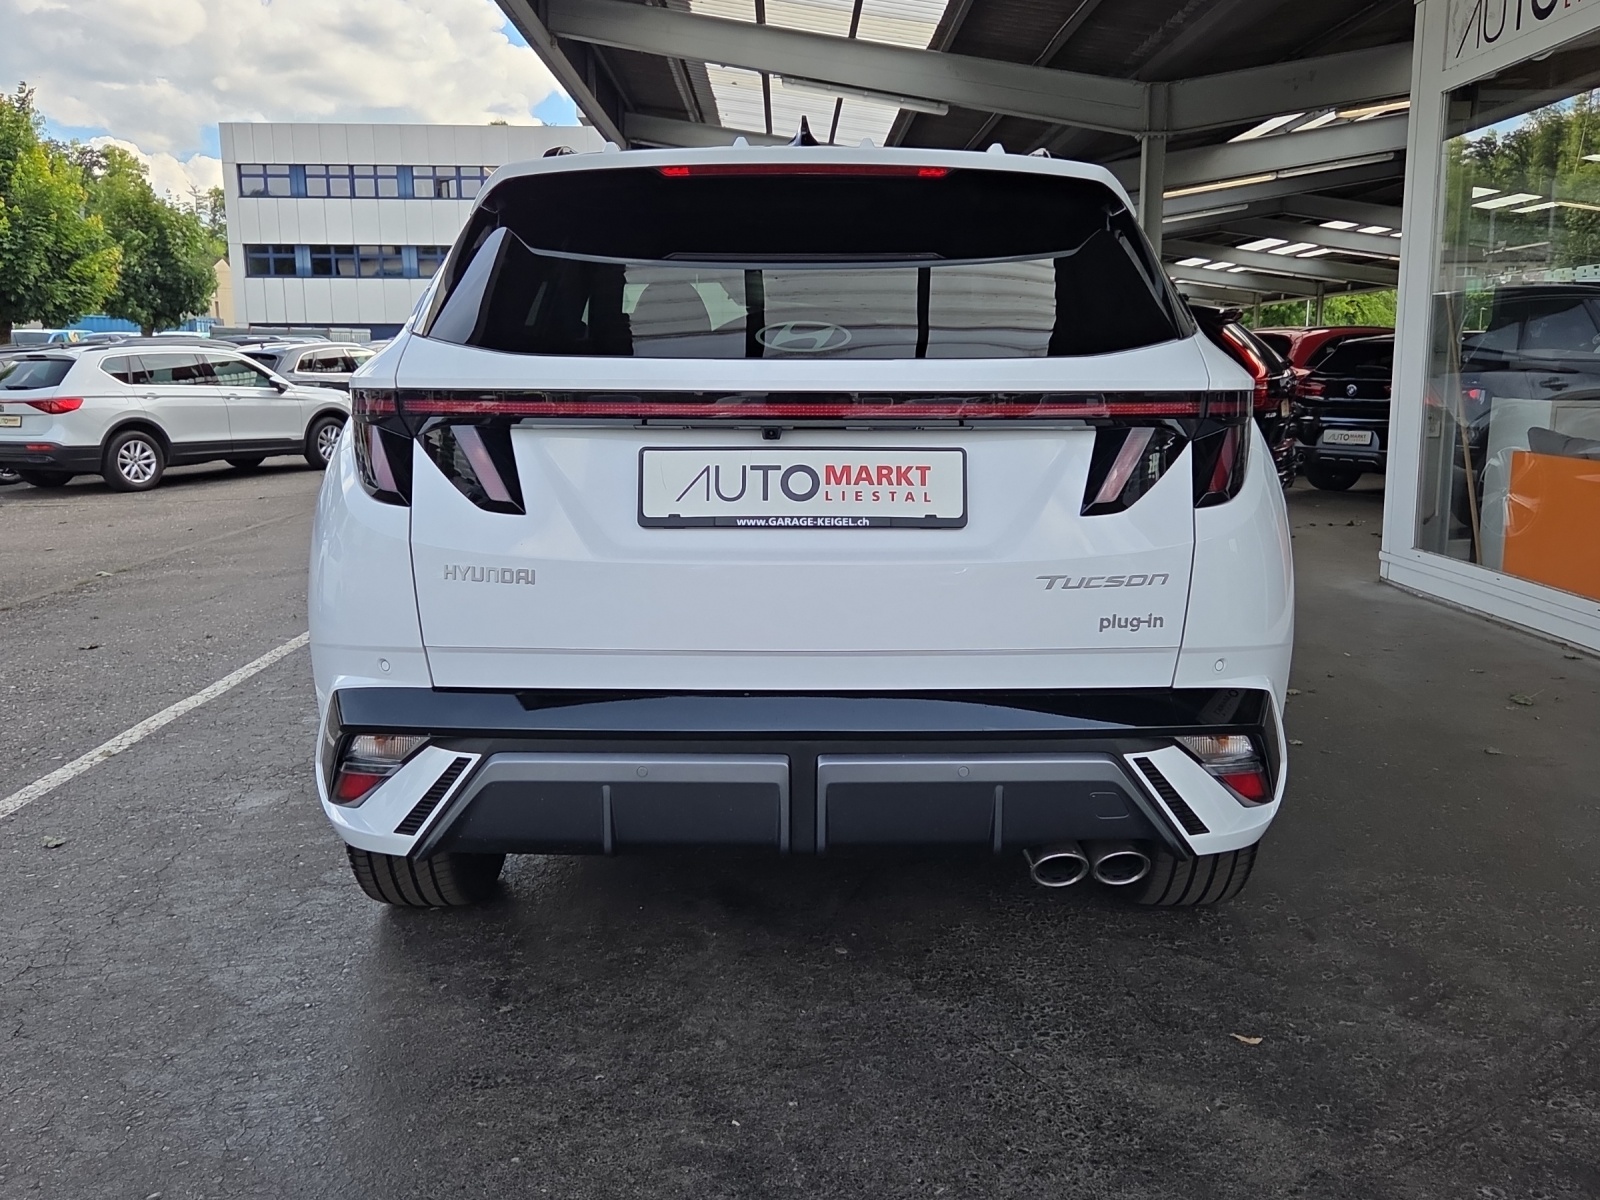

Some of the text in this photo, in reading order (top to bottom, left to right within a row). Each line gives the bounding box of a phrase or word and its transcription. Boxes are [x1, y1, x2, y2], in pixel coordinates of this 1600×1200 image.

[675, 464, 932, 502] AUTO MARKT
[825, 490, 932, 503] LIESTAL
[736, 517, 870, 527] www.GARAGE-KEIGEL.ch
[443, 564, 536, 585] HYUNDAI
[1098, 613, 1164, 632] plug-in
